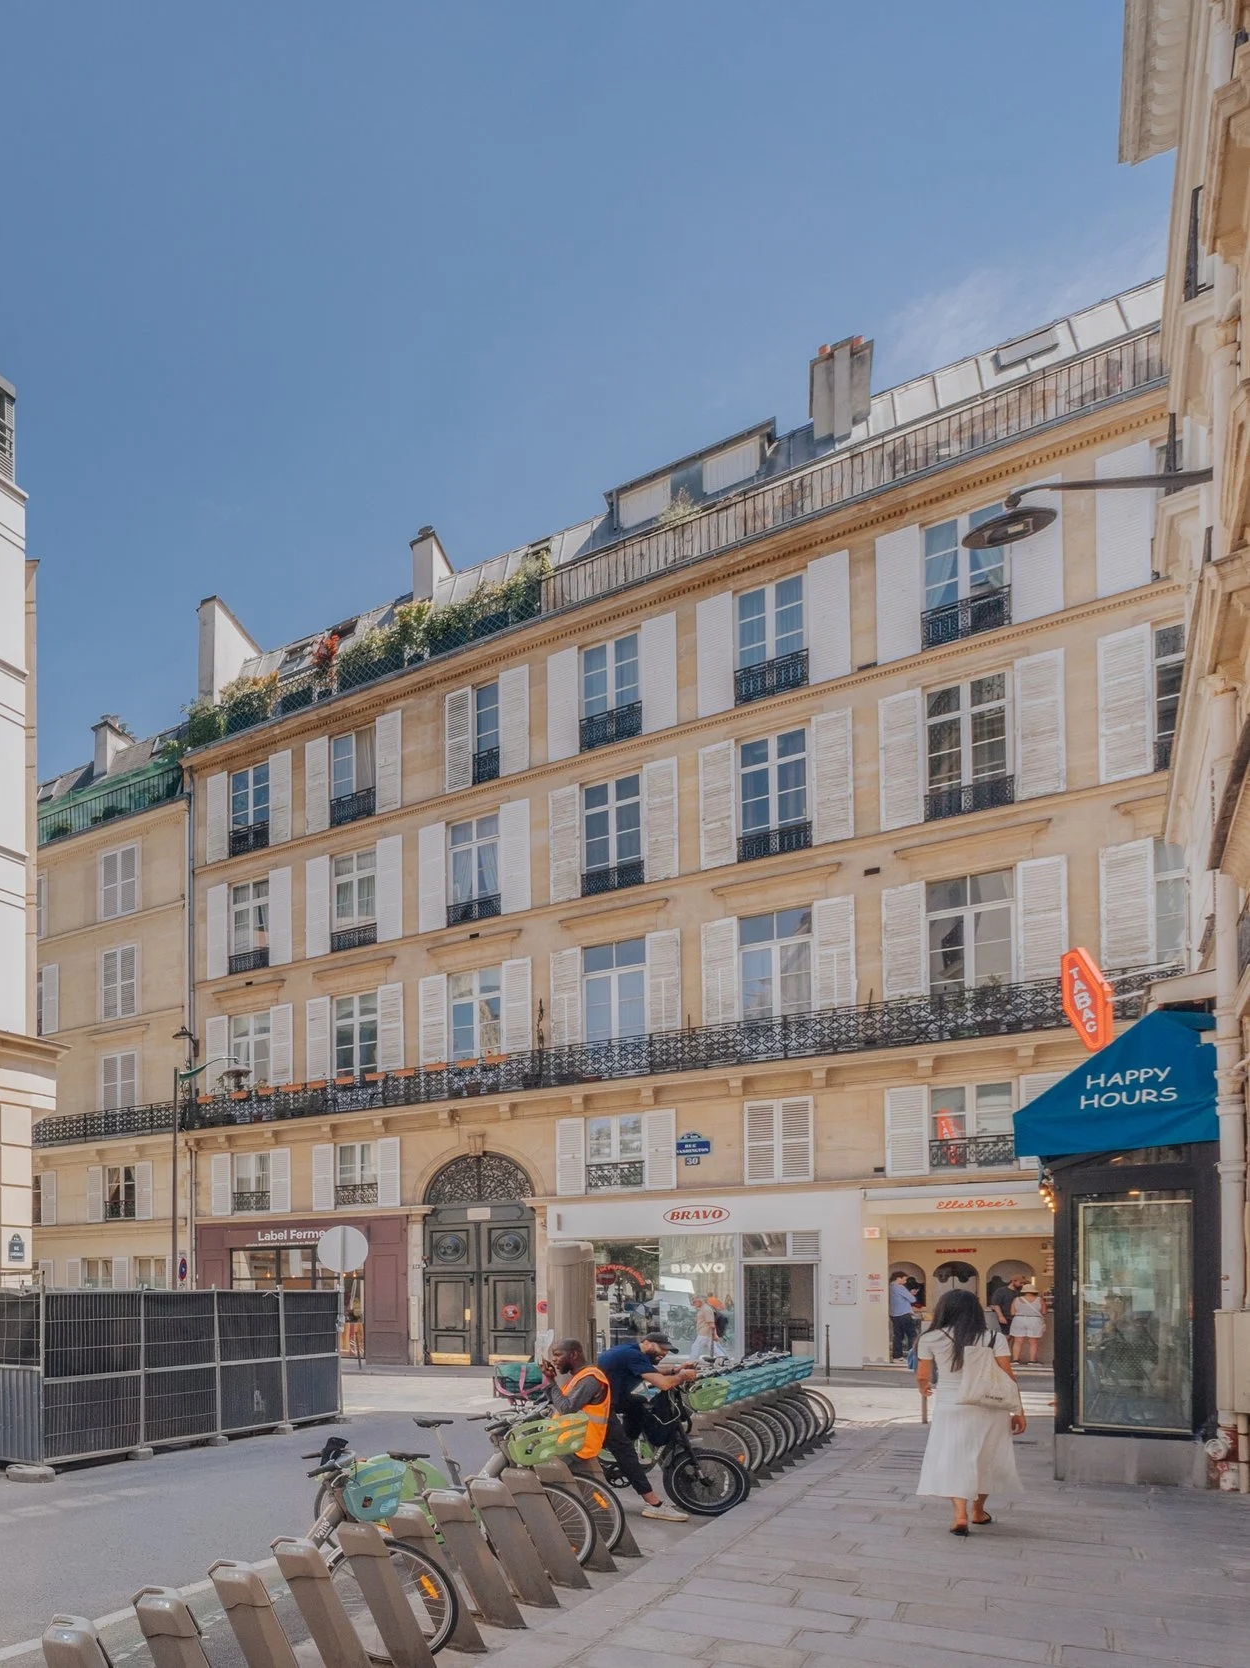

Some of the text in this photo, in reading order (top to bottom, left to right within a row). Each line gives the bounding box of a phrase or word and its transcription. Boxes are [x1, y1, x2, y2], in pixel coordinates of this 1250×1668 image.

[1069, 966, 1098, 1033] TABAC
[1086, 1066, 1172, 1090] HAPPY
[1079, 1087, 1178, 1110] HOURS
[686, 1157, 699, 1165] 30
[670, 1209, 723, 1221] BRAVO
[257, 1229, 326, 1241] Label Ferme
[670, 1262, 726, 1274] BRAVO
